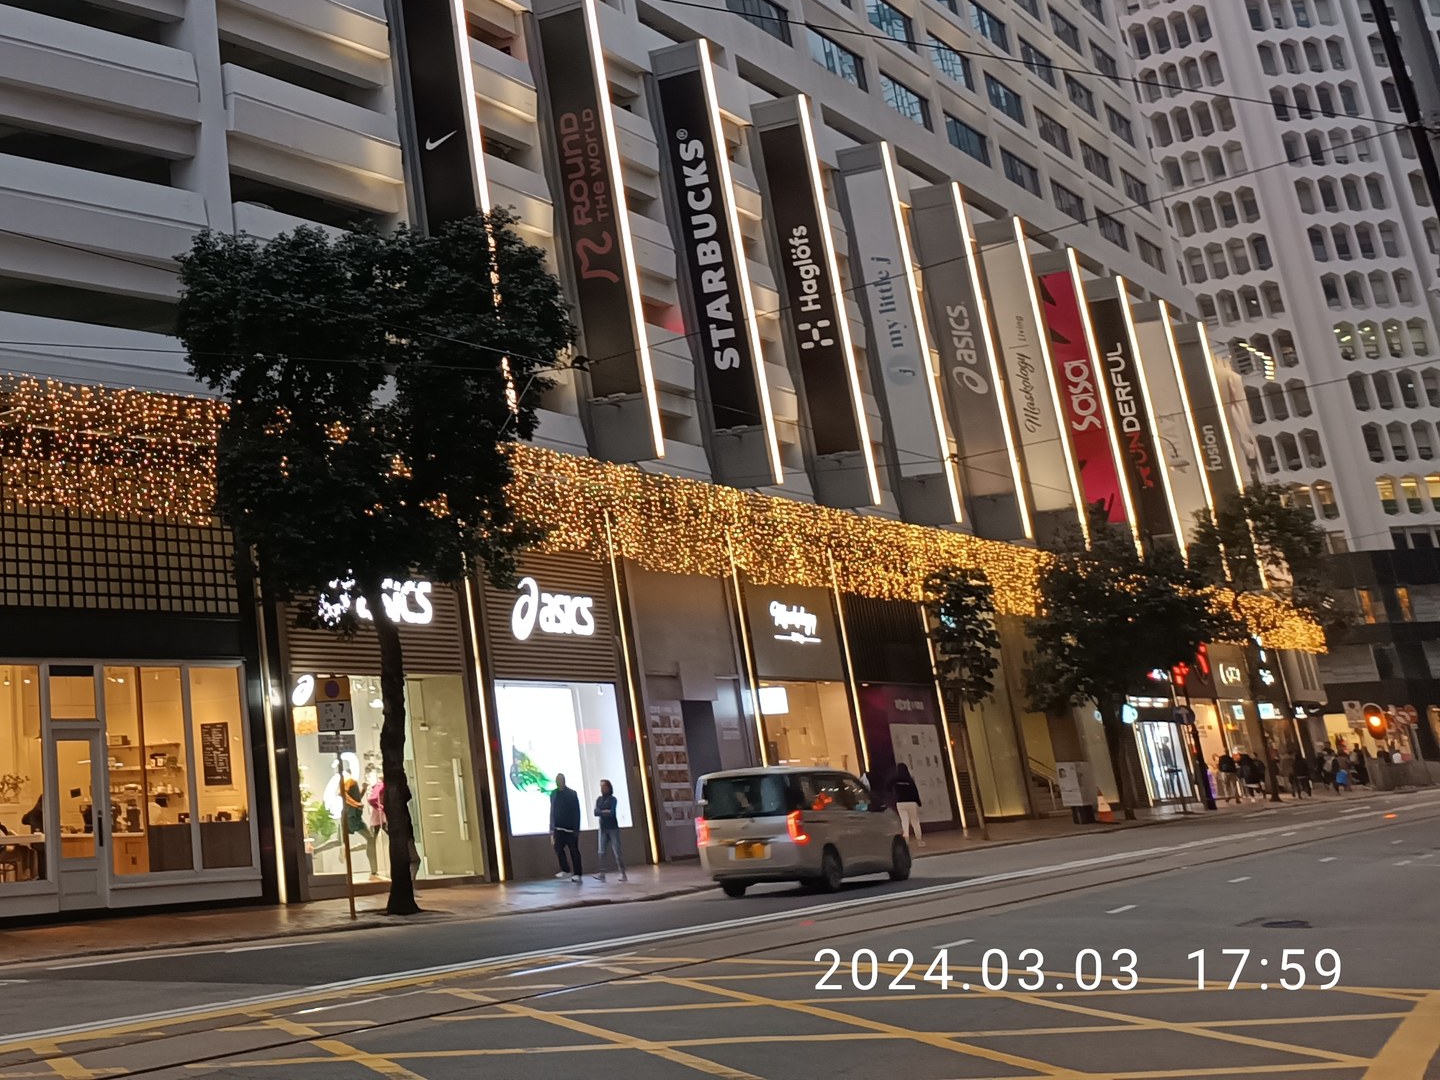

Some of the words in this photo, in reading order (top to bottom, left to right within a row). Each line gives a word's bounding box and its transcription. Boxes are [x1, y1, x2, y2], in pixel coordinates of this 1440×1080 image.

[679, 138, 741, 370] STARBUCKS
[788, 225, 821, 312] Haglöfs
[872, 269, 897, 315] little
[887, 319, 908, 349] my
[1016, 352, 1042, 434] Maskology
[1063, 359, 1102, 431] sasa
[1201, 424, 1223, 472] fusion
